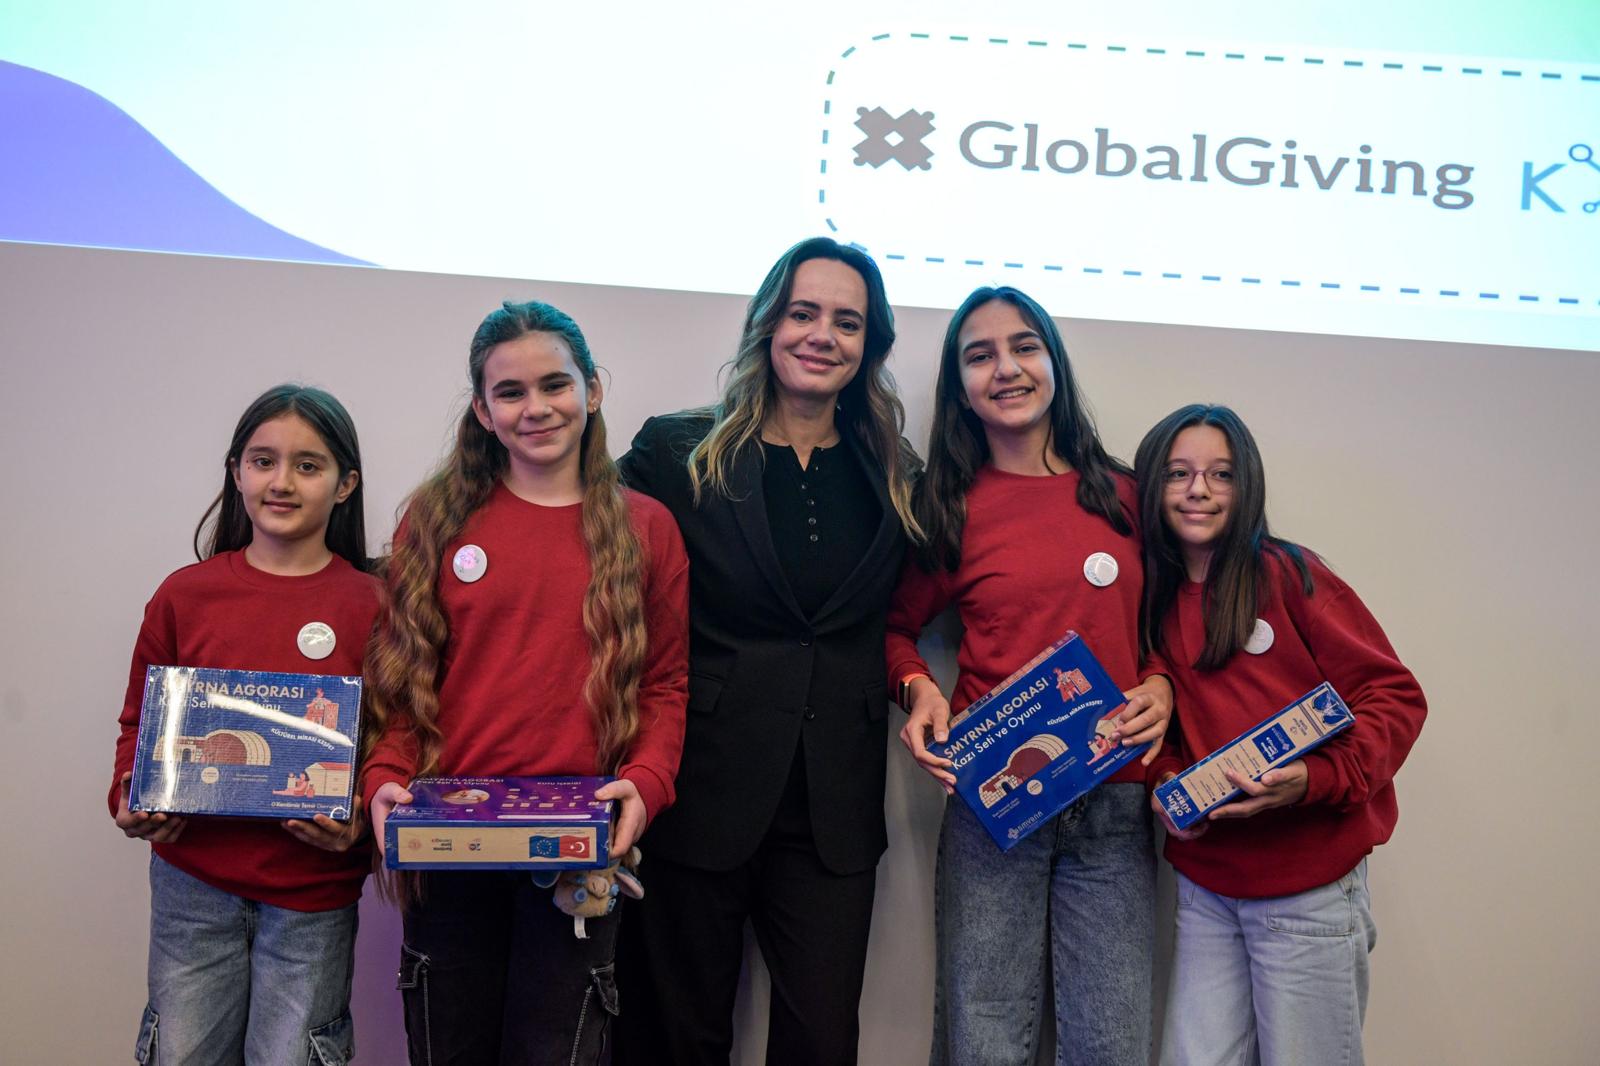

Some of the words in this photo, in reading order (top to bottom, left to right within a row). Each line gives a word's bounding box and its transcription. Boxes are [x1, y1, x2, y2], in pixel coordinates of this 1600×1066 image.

[958, 119, 1476, 211] GlobalGiving
[233, 683, 305, 699] AGORASI
[944, 718, 996, 759] SMYRNA
[996, 677, 1049, 721] AGORASI
[952, 750, 976, 771] Kazı
[977, 734, 994, 753] Seti
[995, 725, 1009, 739] ve
[1007, 702, 1042, 729] Oyunu
[1166, 794, 1184, 817] OYUN
